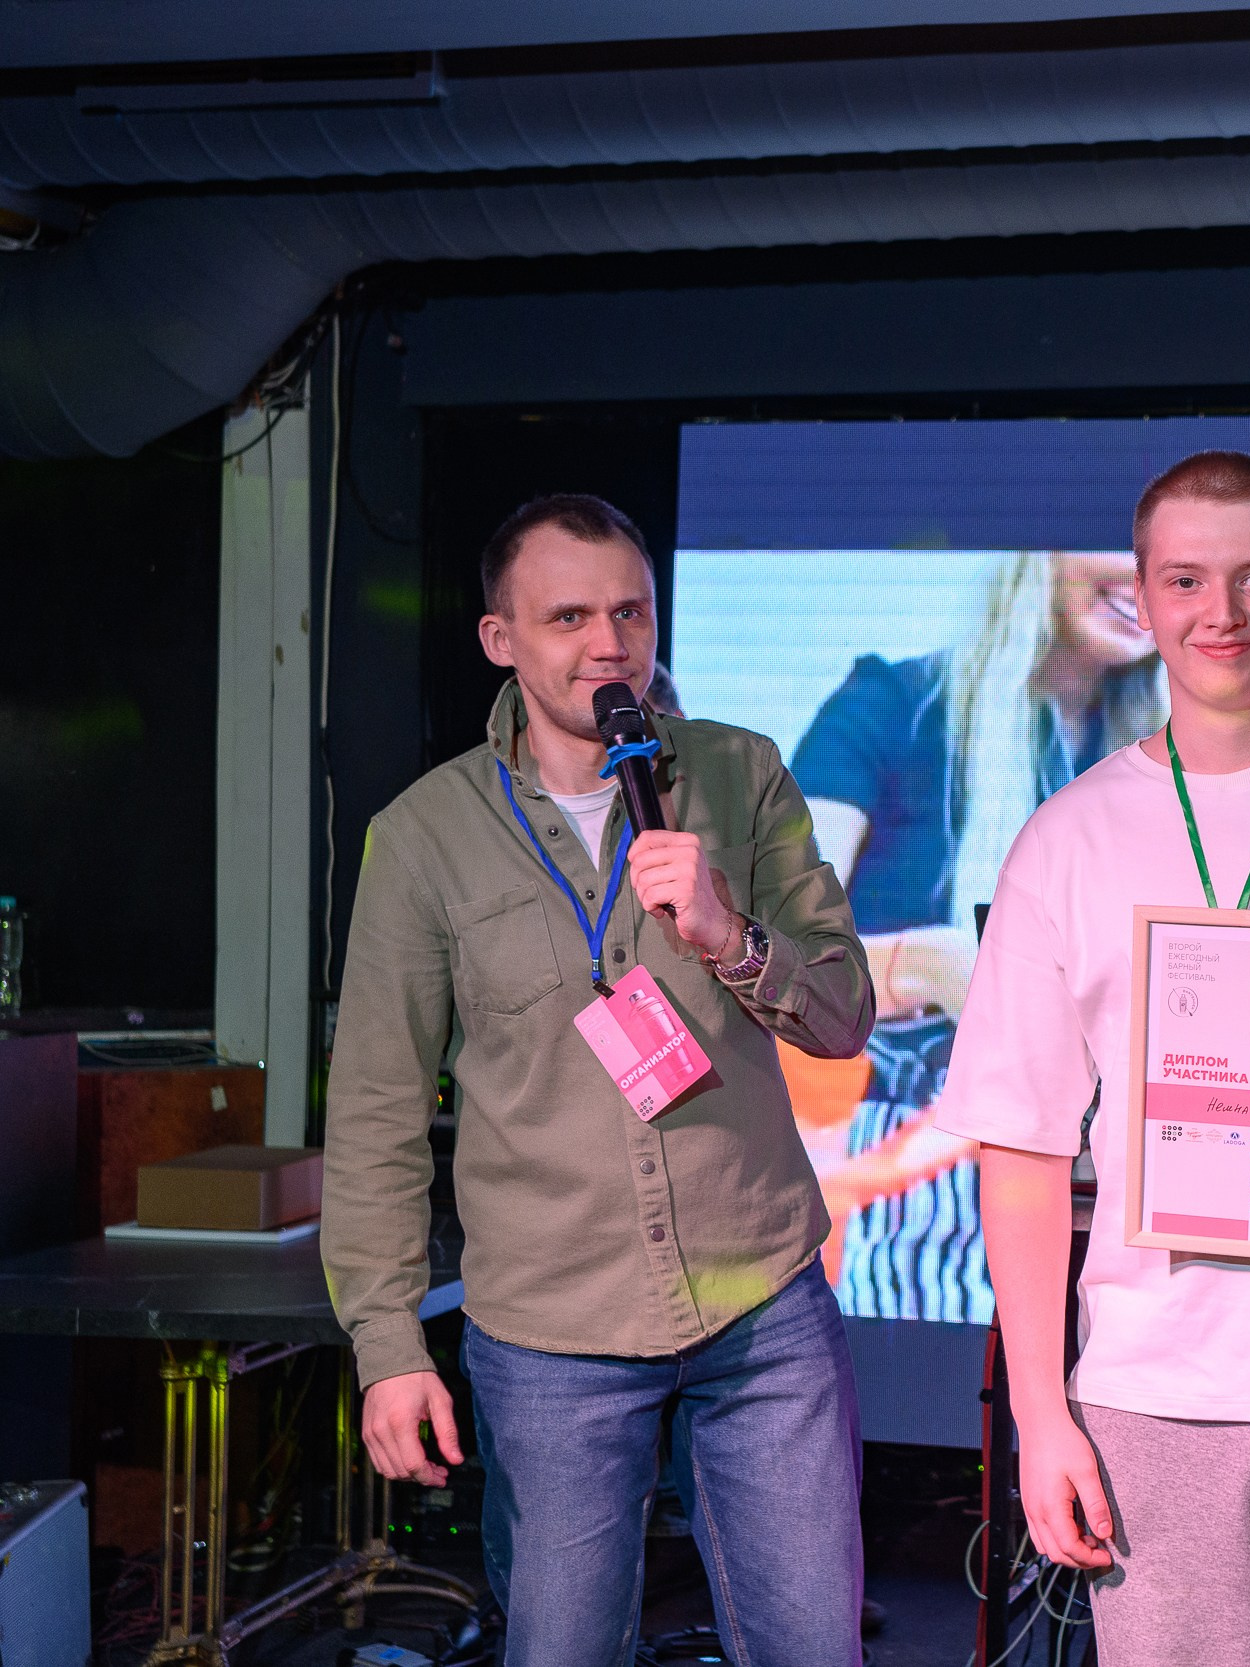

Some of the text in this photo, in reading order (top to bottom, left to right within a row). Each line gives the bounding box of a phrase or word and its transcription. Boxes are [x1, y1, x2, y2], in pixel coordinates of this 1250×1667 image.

[1168, 942, 1202, 952] ВТОРОЙ
[1168, 952, 1220, 963] ЕЖЕГОДНЫЙ
[1168, 962, 1201, 971] БАРНЫЙ
[1167, 972, 1216, 982] ФЕСТИВАЛЬ
[619, 1031, 687, 1090] ОРГАНИЗАТОР
[1163, 1053, 1229, 1068] ДИПЛОМ
[1163, 1067, 1249, 1084] УЧАСТНИКА
